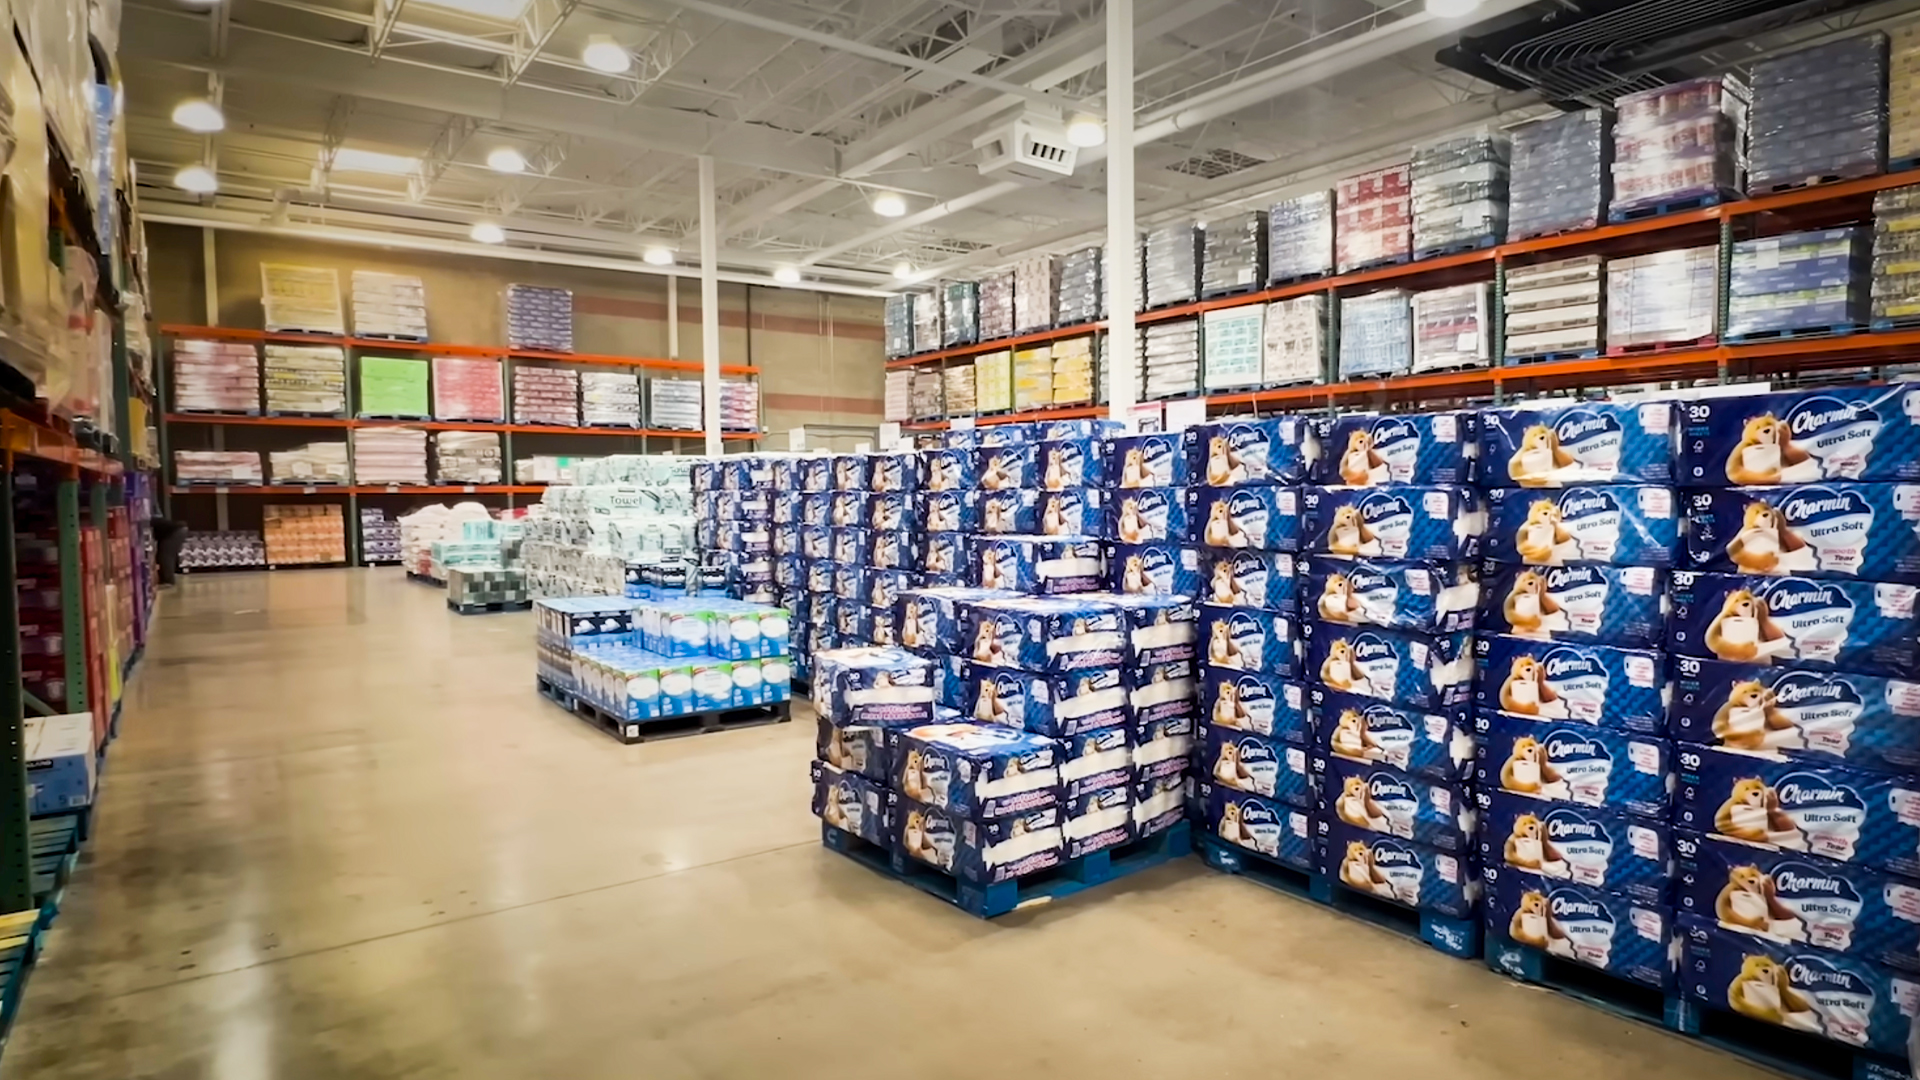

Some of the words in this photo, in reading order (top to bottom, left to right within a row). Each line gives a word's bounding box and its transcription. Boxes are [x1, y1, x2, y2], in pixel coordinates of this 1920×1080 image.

[1689, 406, 1710, 418] 30
[1792, 406, 1859, 434] Charmin
[1558, 418, 1608, 442] Charmin
[1600, 437, 1618, 448] Soft
[1817, 435, 1846, 449] Ultra
[1847, 428, 1872, 442] Soft
[610, 495, 642, 505] Towel
[1305, 495, 1319, 505] 30
[1489, 488, 1504, 499] 30
[1562, 496, 1607, 518] Charmin
[1692, 495, 1712, 507] 30
[1785, 495, 1851, 521] Charmin
[1599, 518, 1617, 526] Soft
[1810, 525, 1839, 538] Ultra
[1841, 521, 1864, 532] Soft
[1548, 565, 1593, 588] Charmin
[1673, 575, 1694, 586] 30
[1585, 590, 1602, 599] Soft
[1769, 589, 1833, 611] Charmin
[1792, 619, 1820, 629] Ultra
[1821, 616, 1845, 625] Soft
[1547, 657, 1593, 676] Charmin
[1680, 660, 1700, 674] 30
[1311, 691, 1324, 702] 30
[1777, 684, 1842, 703] Charmin
[1800, 710, 1829, 721] Ultra
[1475, 718, 1490, 730] 30
[1548, 739, 1596, 757] Charmin
[1313, 758, 1325, 769] 30
[1680, 753, 1700, 767] 30
[1779, 784, 1845, 804] Charmin
[1804, 813, 1832, 823] Ultra
[1833, 813, 1857, 824] Soft
[1549, 818, 1596, 837] Charmin
[1677, 840, 1696, 854] 30
[1776, 872, 1842, 895] Charmin
[1552, 896, 1599, 917] Charmin
[1801, 903, 1829, 914] Ultra
[1829, 905, 1852, 917] Soft
[1789, 963, 1852, 989] Charmin
